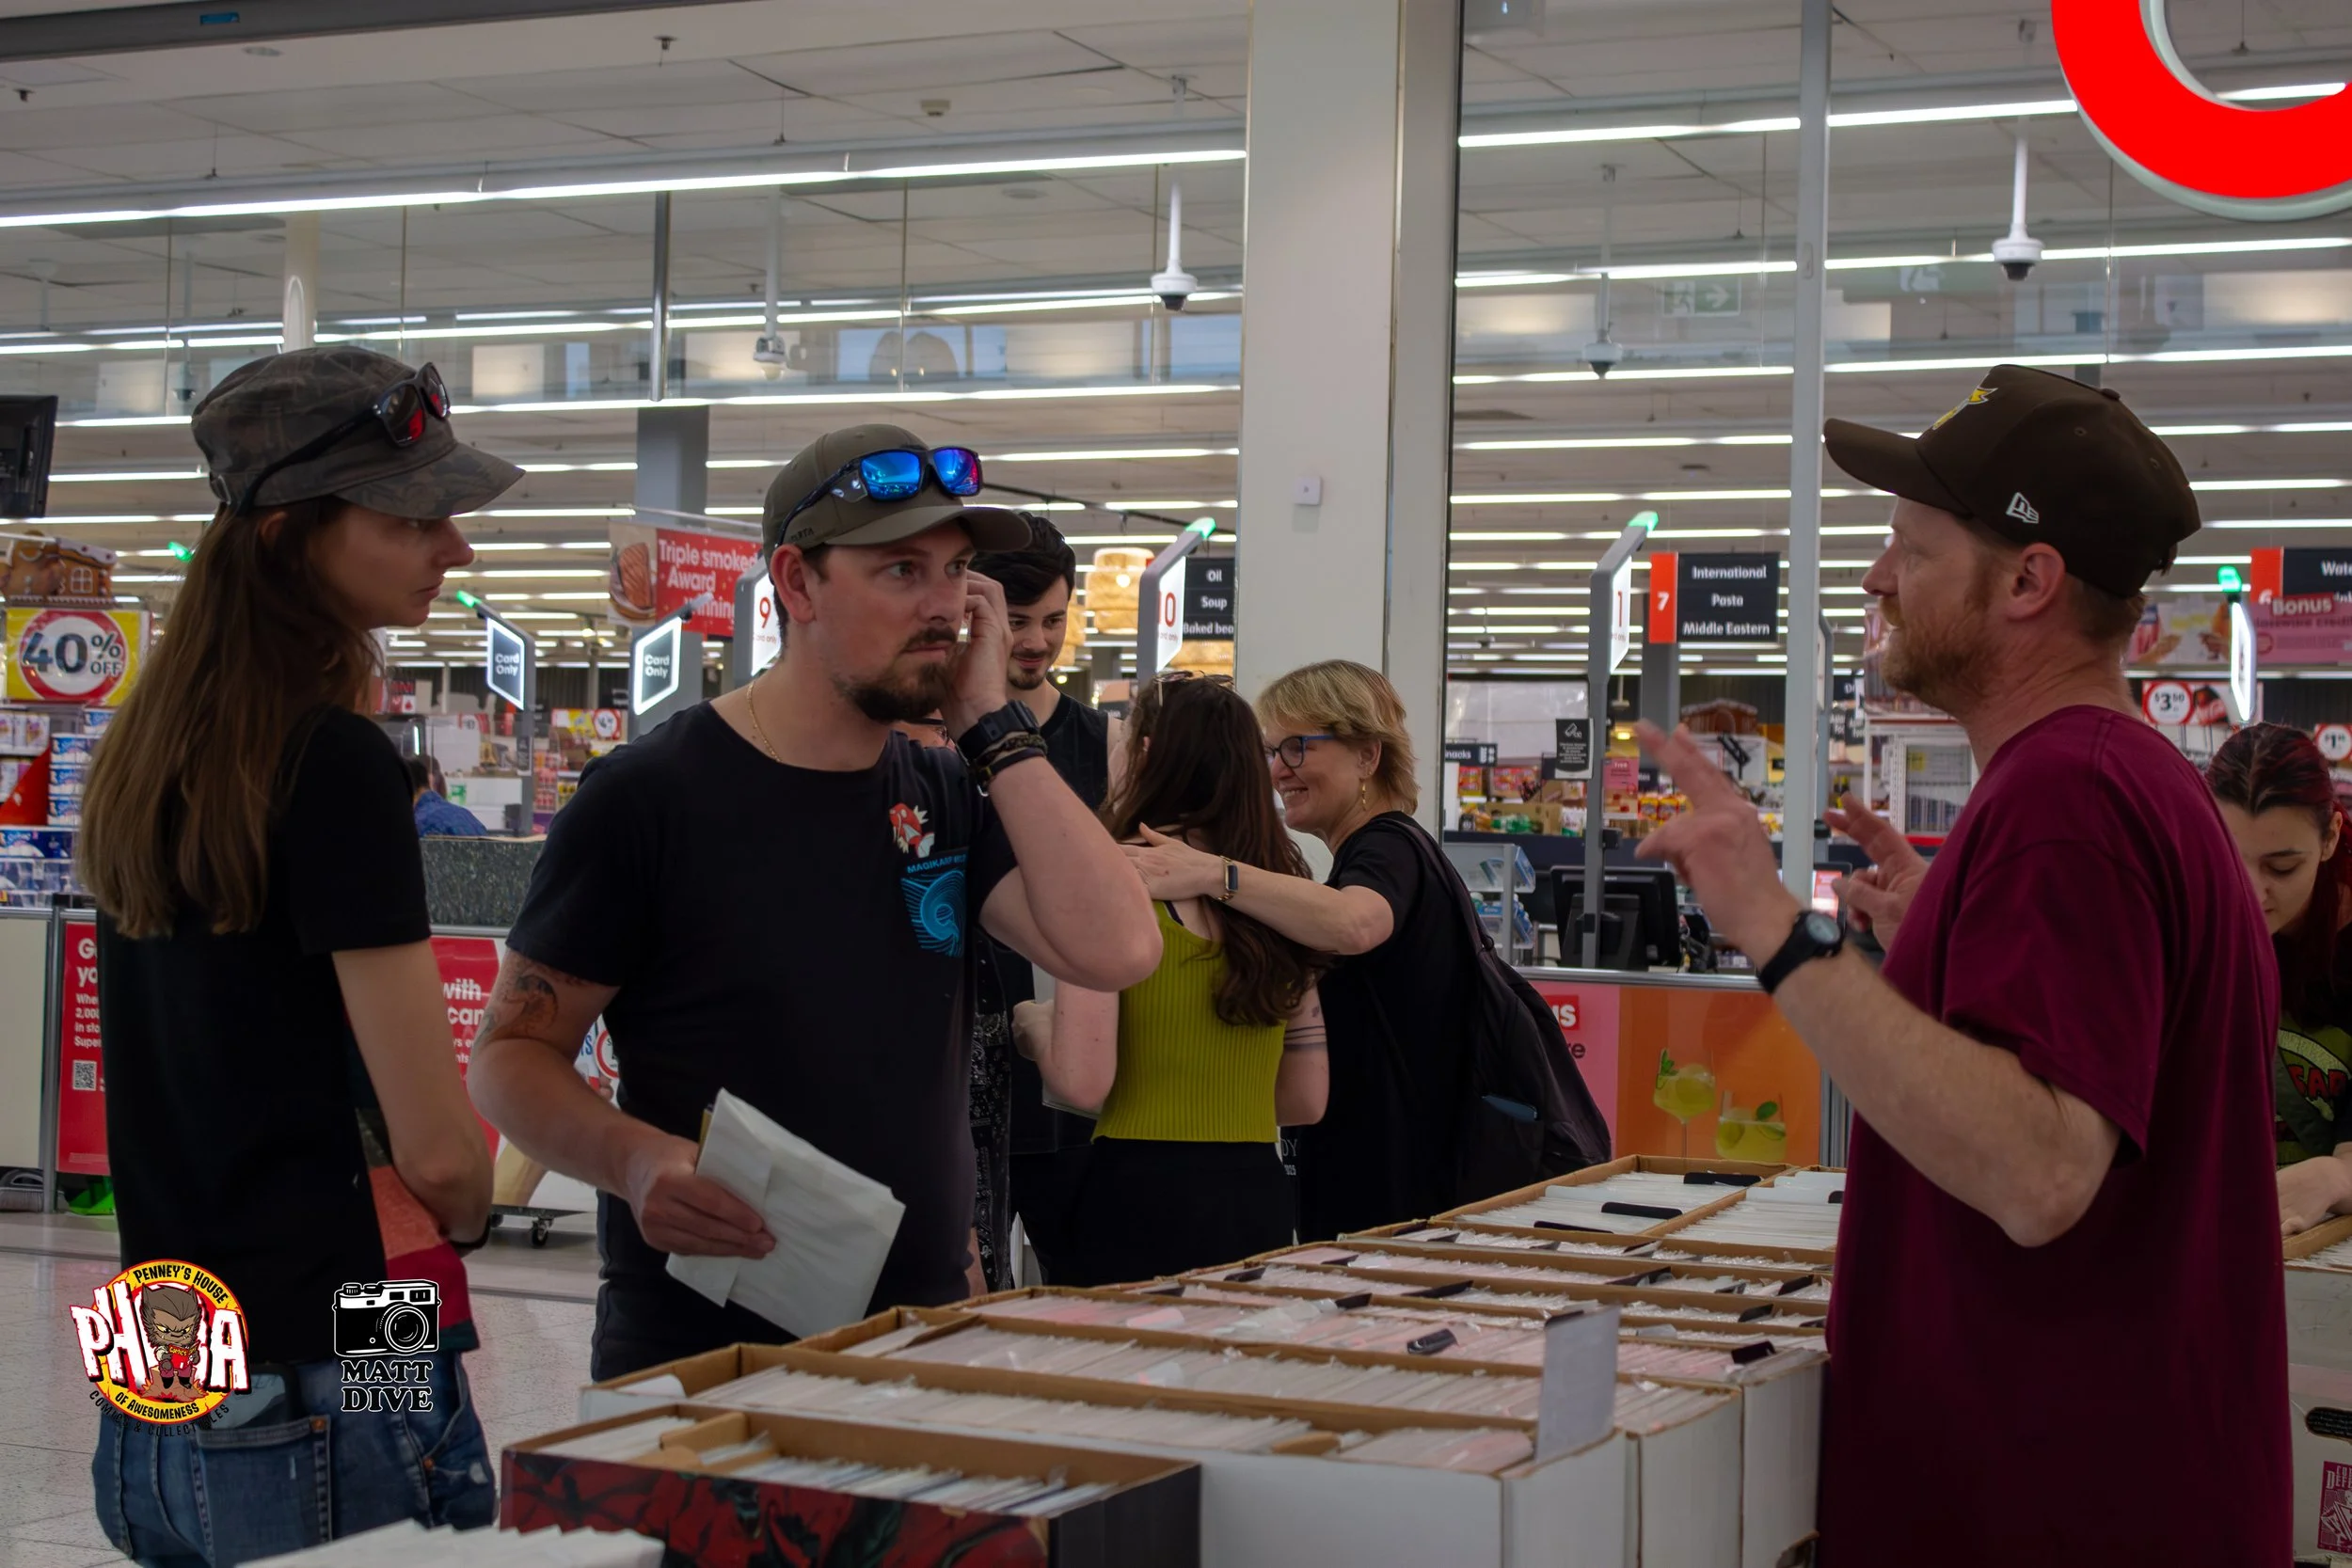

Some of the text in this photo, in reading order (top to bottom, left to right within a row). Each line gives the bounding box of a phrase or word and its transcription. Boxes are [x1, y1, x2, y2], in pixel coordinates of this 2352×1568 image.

[660, 540, 757, 573] Triple smoked
[667, 566, 716, 592] Award
[1206, 569, 1222, 582] Oil
[1692, 565, 1767, 579] International
[1200, 596, 1228, 610] Soup
[1657, 591, 1670, 611] 7
[1711, 593, 1743, 607] Pasta
[2272, 596, 2332, 616] Bonus
[759, 596, 771, 629] 9
[1183, 621, 1213, 634] Baked
[1682, 621, 1771, 636] Middle Eastern
[495, 653, 519, 664] Card
[644, 654, 670, 666] Card
[90, 661, 122, 674] OFF
[496, 664, 518, 676] Only
[644, 666, 668, 679] Only
